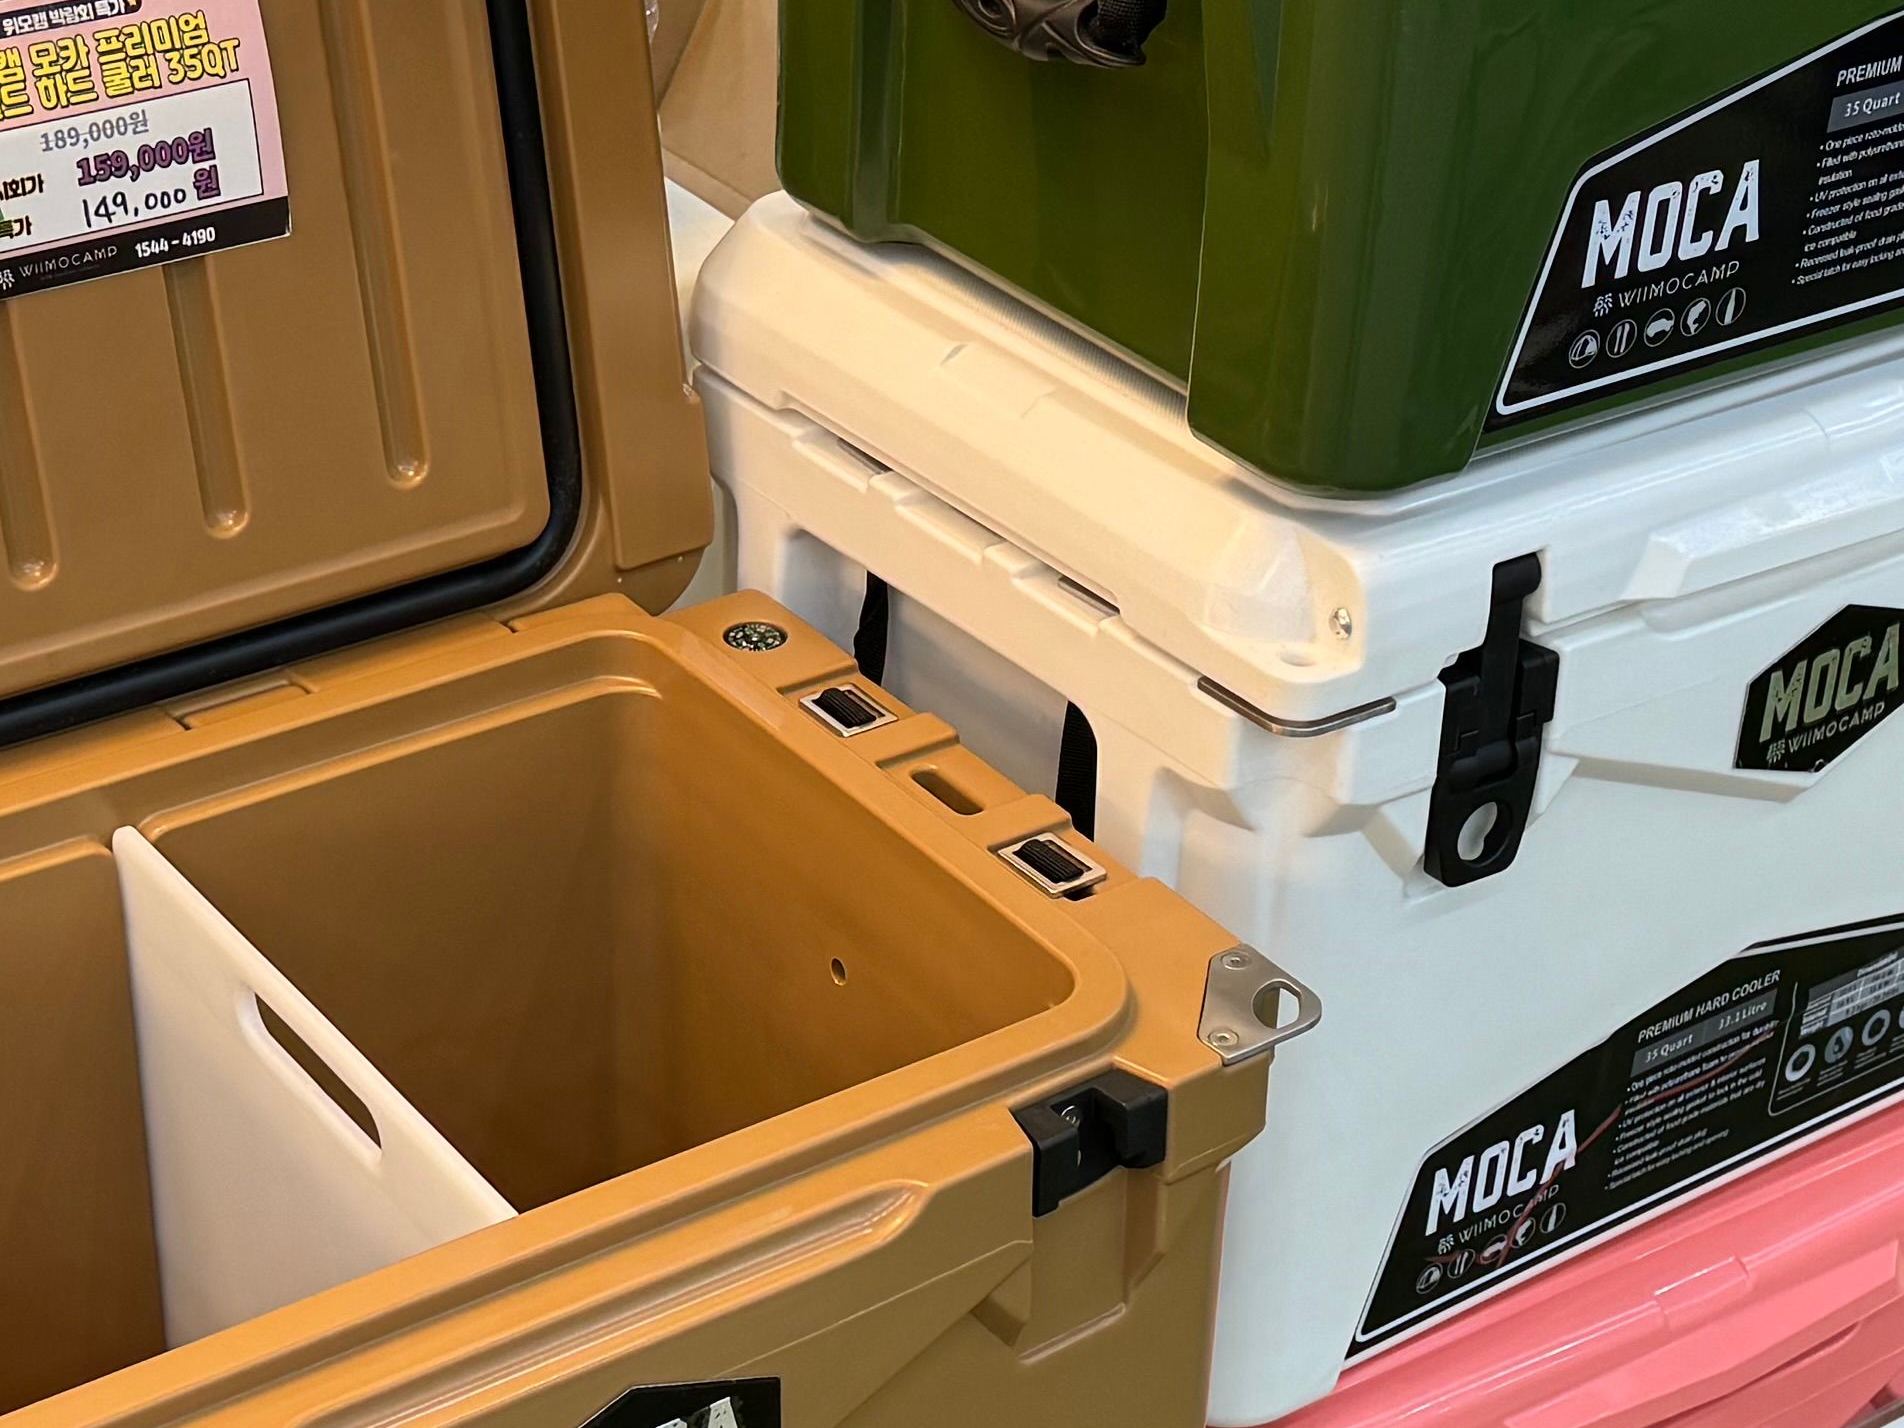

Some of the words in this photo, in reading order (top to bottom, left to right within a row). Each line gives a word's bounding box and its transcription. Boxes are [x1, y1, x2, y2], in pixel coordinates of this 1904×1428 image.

[29, 35, 91, 77] 모카
[93, 10, 210, 63] 프리미엄
[34, 68, 98, 110] 하드
[100, 54, 163, 98] 쿨러
[165, 38, 241, 85] 35QT
[1836, 56, 1903, 87] PREMIUM
[1844, 102, 1860, 117] 35
[1862, 92, 1901, 111] Quart
[40, 109, 150, 153] 189,000원
[76, 127, 216, 187] 159,000원
[82, 188, 187, 229] 149,000
[1581, 159, 1760, 289] MOCA
[19, 245, 118, 278] WIIMOCAMP
[1618, 261, 1740, 308] WIIMOCAMP
[1759, 622, 1900, 743] MOCA
[1788, 702, 1885, 754] WIIMOCAMP
[1638, 1008, 1694, 1044] PREMIUM
[1696, 994, 1729, 1018] HARD
[1732, 970, 1781, 1001] COOLER
[1660, 1033, 1694, 1057] Quart
[1425, 1109, 1577, 1236] MOCA
